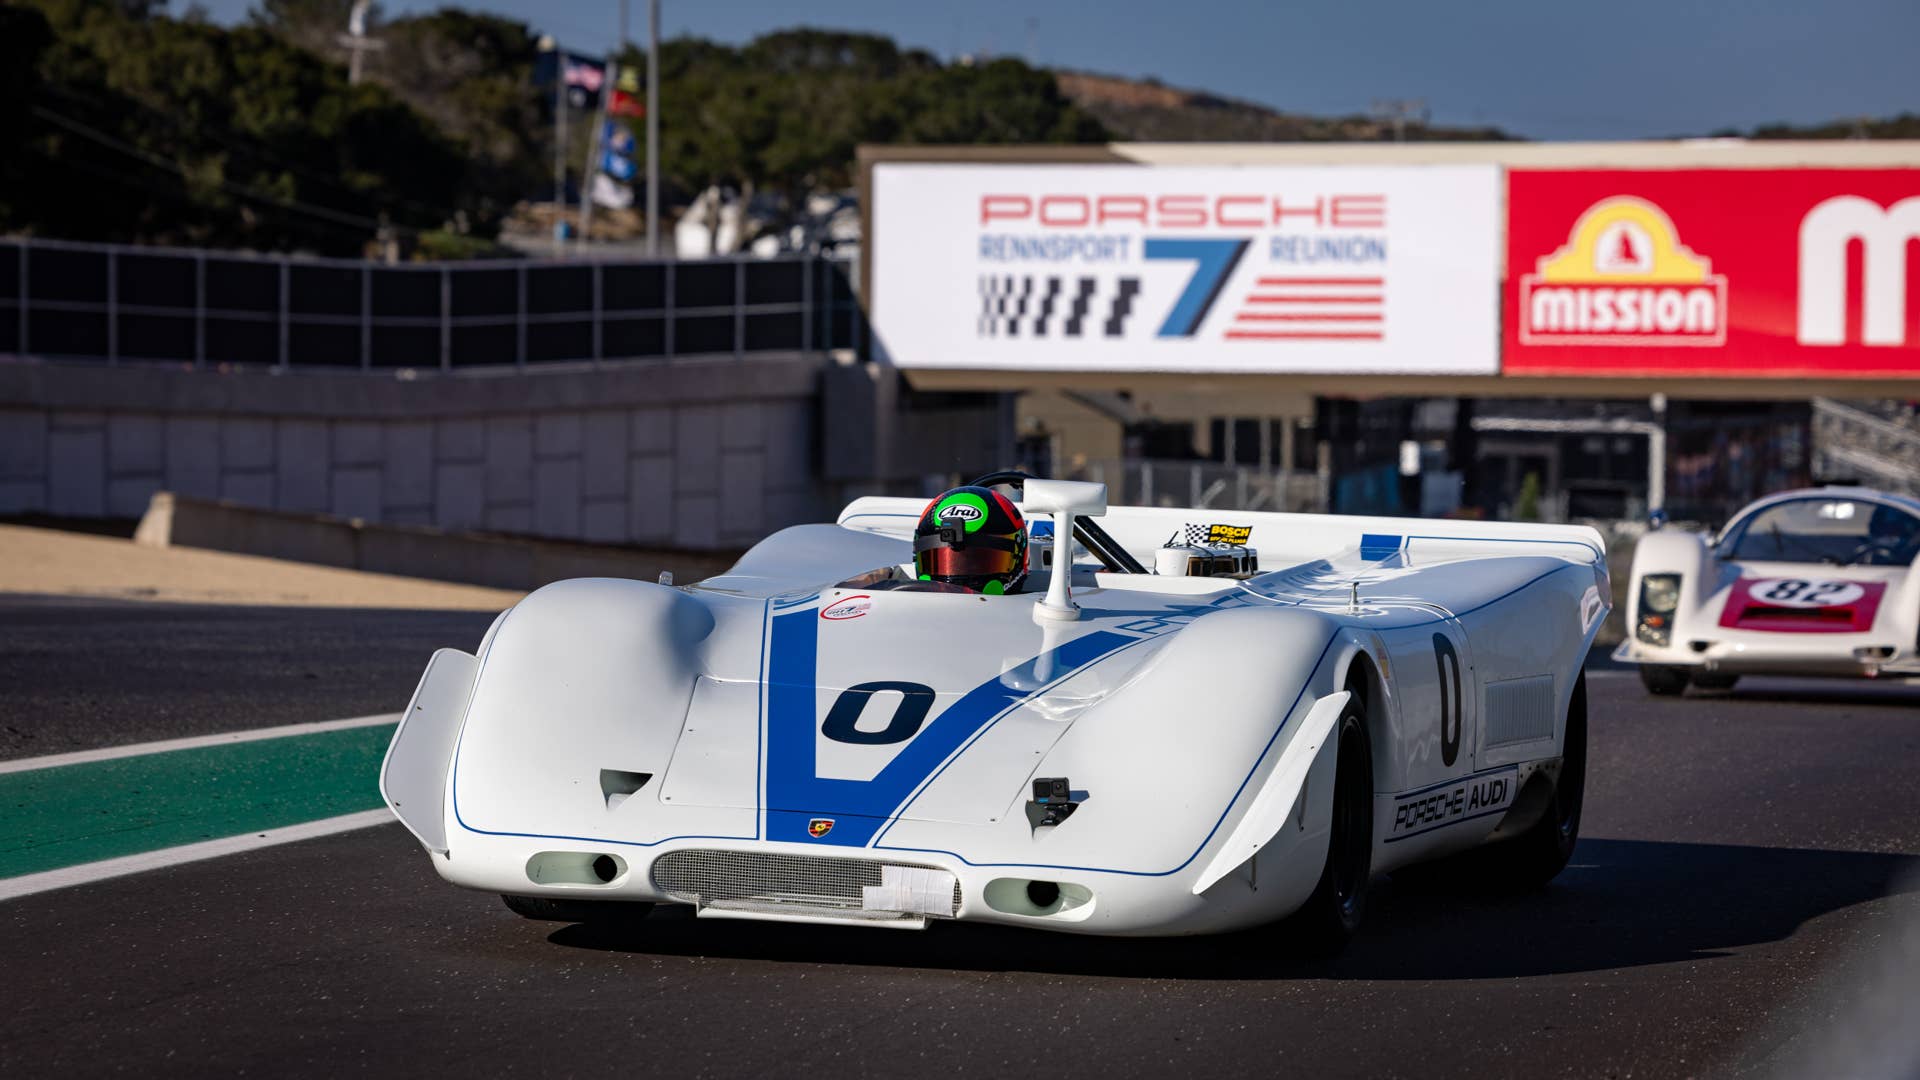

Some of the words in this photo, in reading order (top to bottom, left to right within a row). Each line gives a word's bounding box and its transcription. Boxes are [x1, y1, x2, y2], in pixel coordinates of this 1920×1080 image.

[980, 194, 1386, 227] PORSCHE
[979, 234, 1130, 261] RENNSPORT
[1143, 238, 1252, 338] 7
[1269, 235, 1386, 262] REUNION
[1531, 288, 1716, 333] MISSION
[941, 505, 977, 517] Arai
[1211, 525, 1250, 537] BOSCH
[1764, 579, 1848, 605] 82
[821, 680, 937, 745] 0
[1431, 632, 1462, 768] 0
[1394, 789, 1465, 832] PORSCHE
[1468, 778, 1508, 811] AUDI
